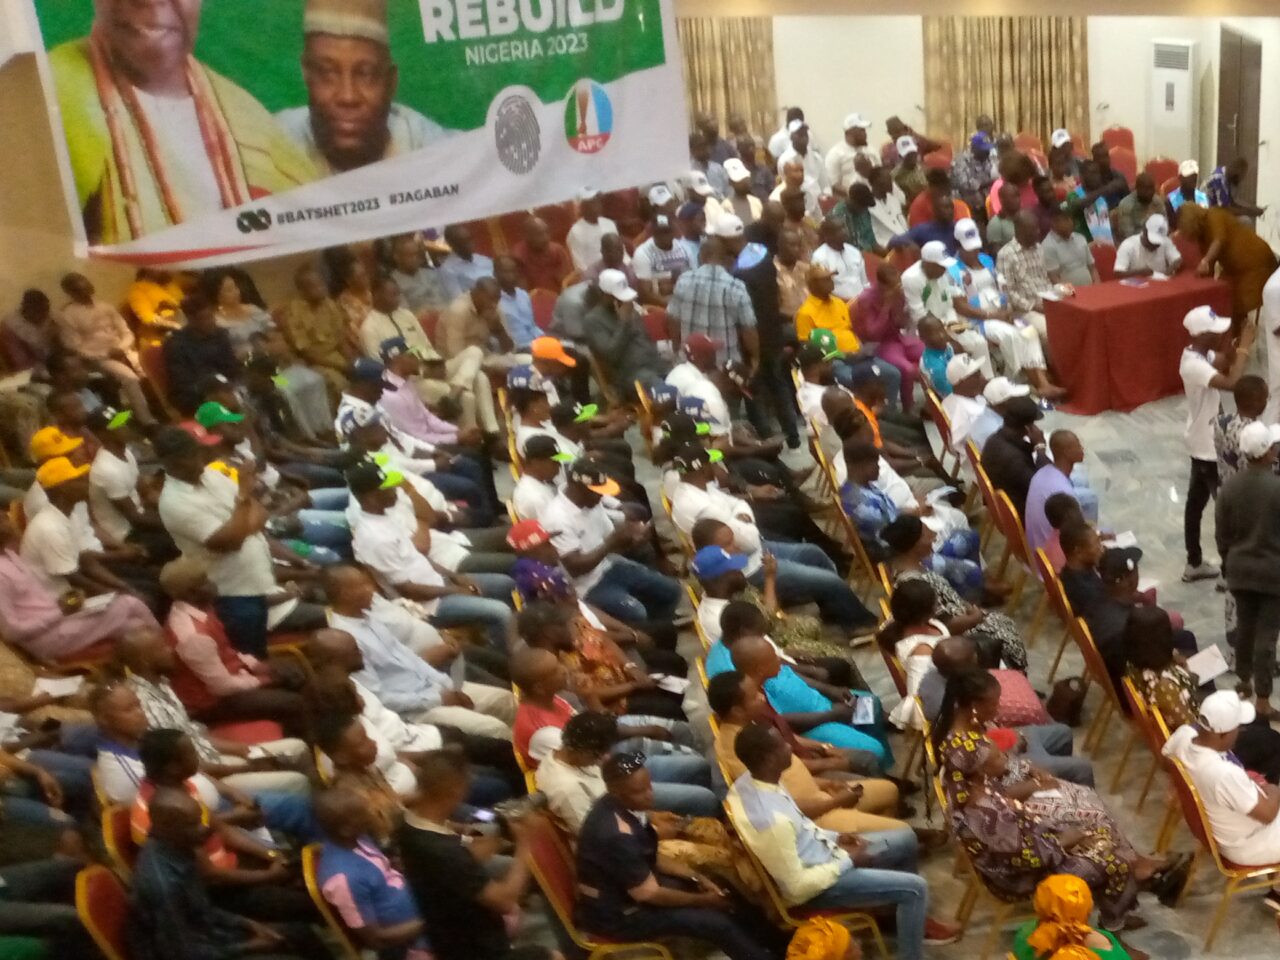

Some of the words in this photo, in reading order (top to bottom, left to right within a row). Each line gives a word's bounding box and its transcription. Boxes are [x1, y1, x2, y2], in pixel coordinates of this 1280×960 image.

[465, 38, 544, 66] NIGERIA
[547, 32, 589, 56] 2023
[577, 137, 601, 152] APC
[277, 197, 381, 225] #BATSHET2023
[389, 183, 459, 206] #JAGABAN
